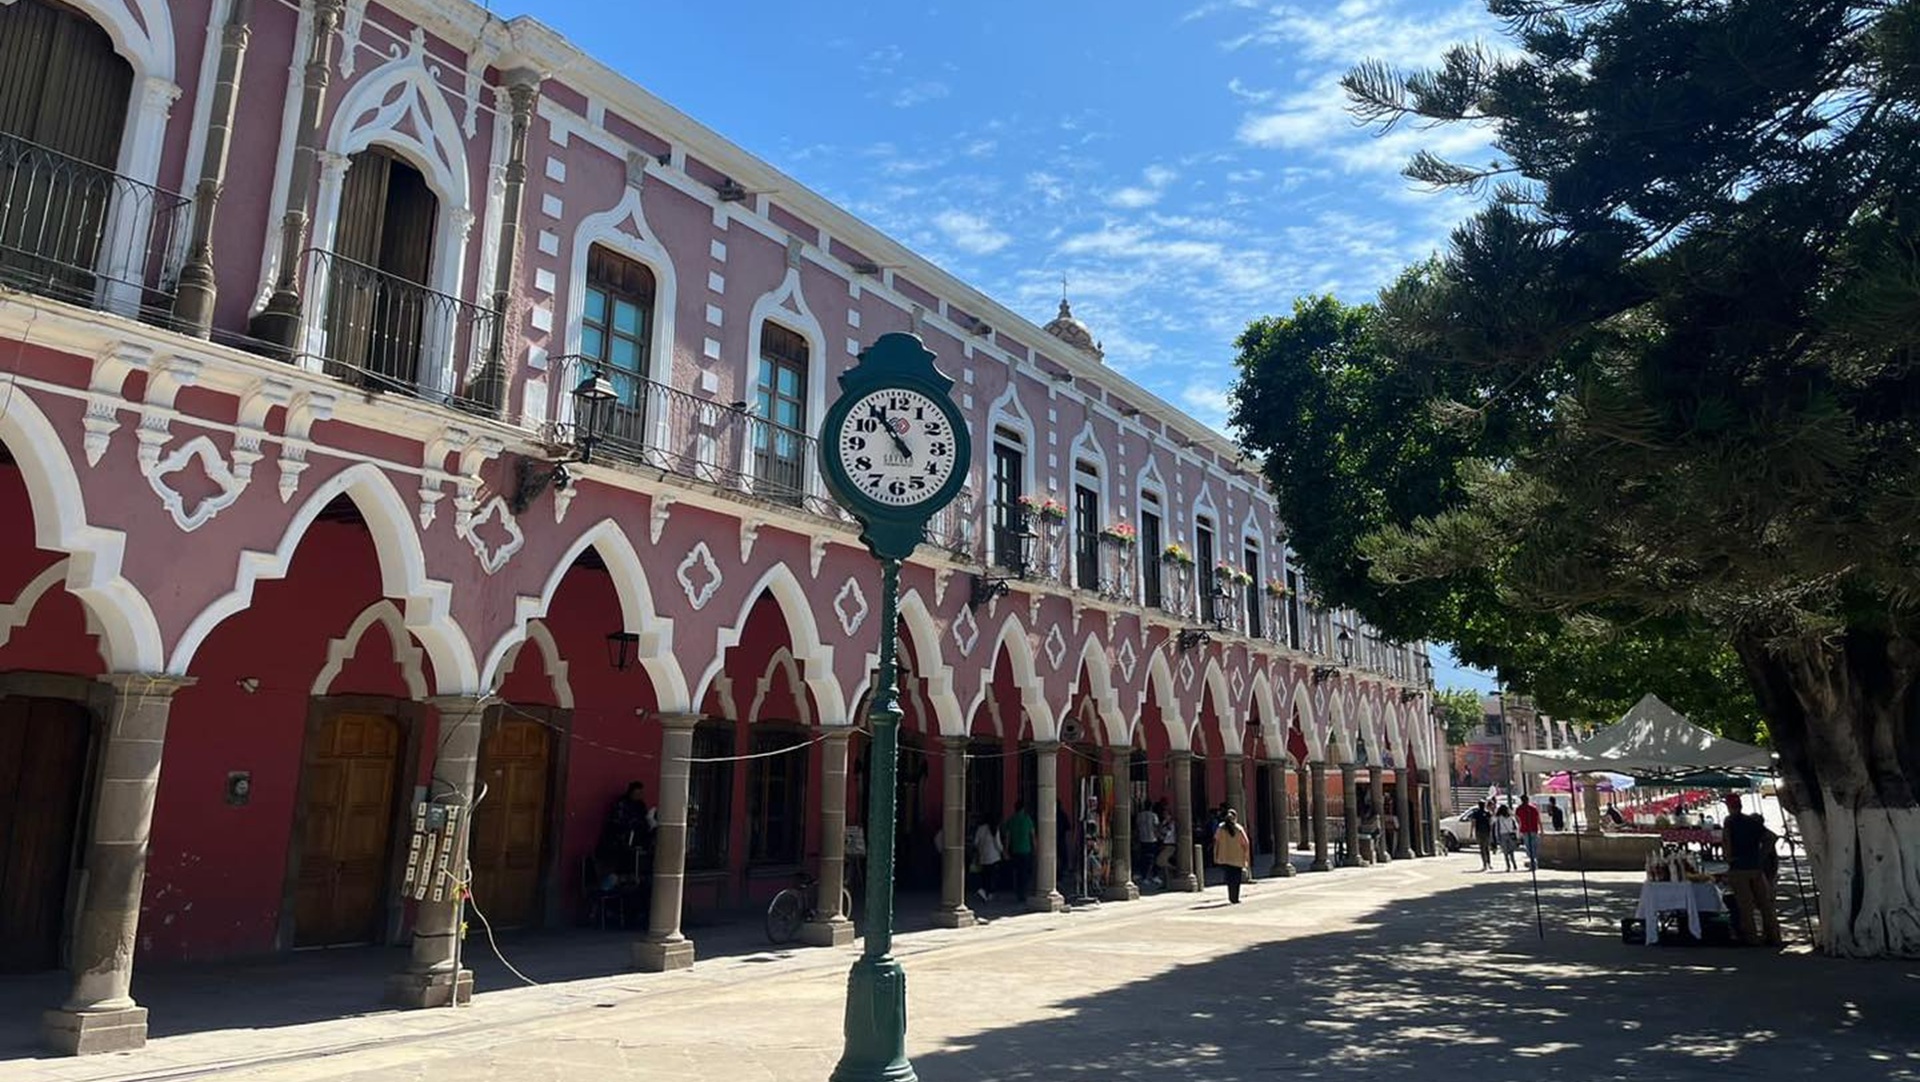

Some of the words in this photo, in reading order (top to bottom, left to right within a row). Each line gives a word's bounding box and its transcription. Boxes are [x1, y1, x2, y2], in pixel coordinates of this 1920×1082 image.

[889, 398, 911, 411] 12
[915, 407, 924, 420] 1
[856, 419, 877, 433] 10
[924, 422, 941, 436] 2
[849, 436, 865, 451] 9
[930, 442, 946, 456] 3
[855, 456, 872, 471] 8
[924, 461, 939, 475] 4
[868, 474, 885, 488] 7
[908, 476, 925, 489] 5
[889, 481, 906, 496] 6
